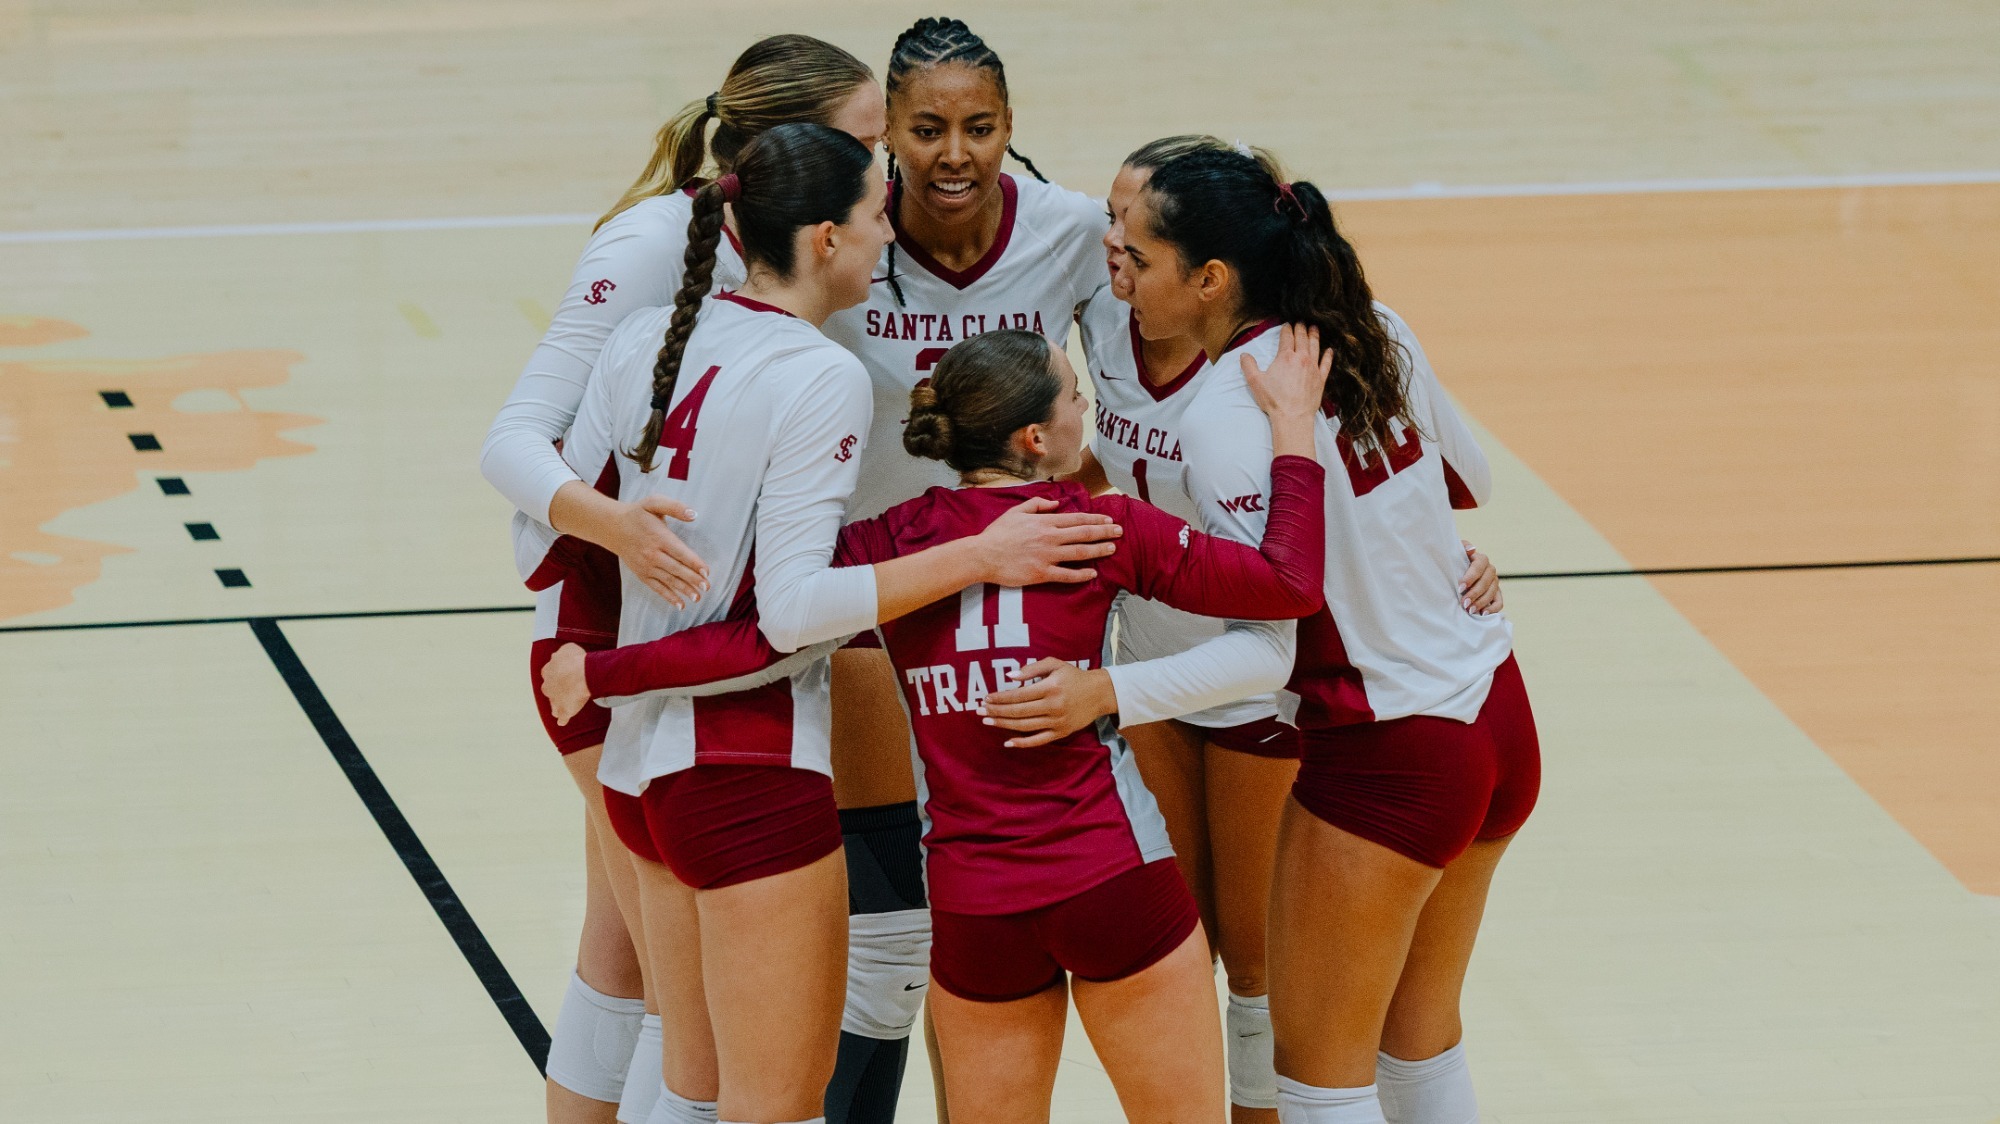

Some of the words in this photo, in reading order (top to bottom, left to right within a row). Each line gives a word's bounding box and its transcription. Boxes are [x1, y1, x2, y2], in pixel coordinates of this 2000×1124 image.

[866, 309, 953, 341] SANTA
[658, 365, 722, 481] 4
[1216, 493, 1265, 514] WCC
